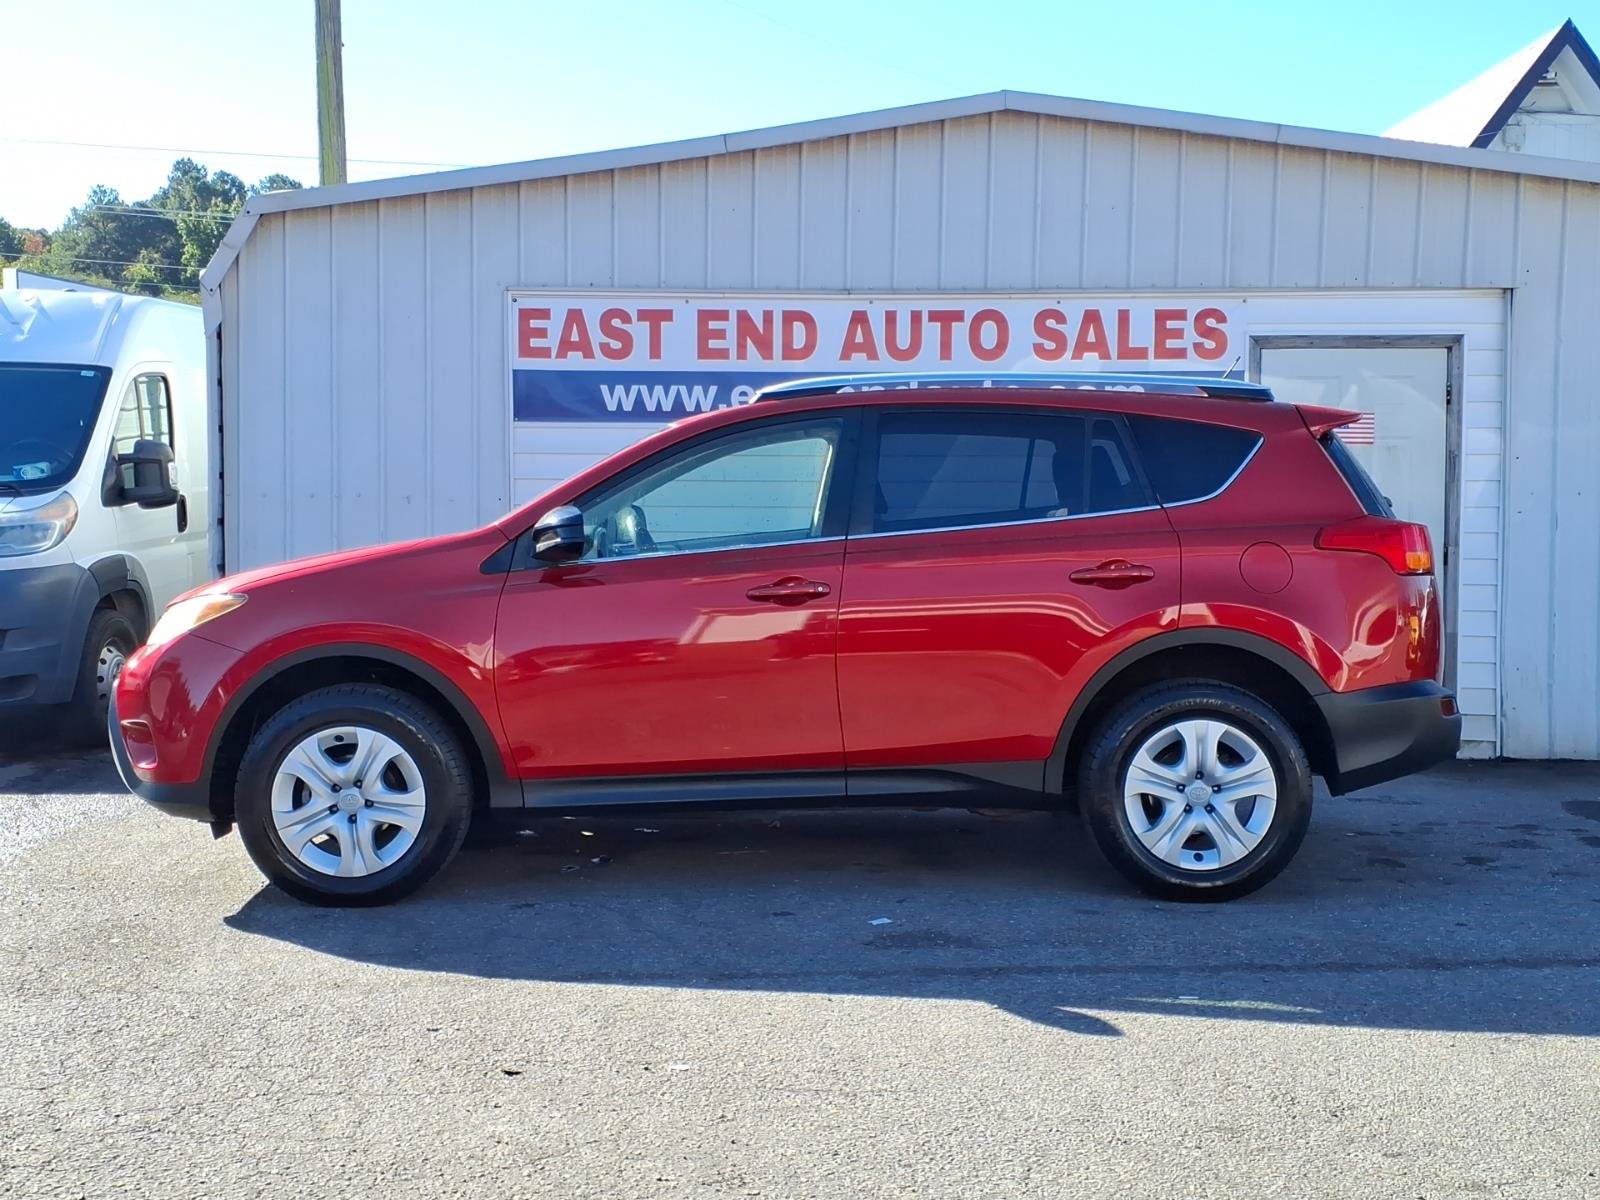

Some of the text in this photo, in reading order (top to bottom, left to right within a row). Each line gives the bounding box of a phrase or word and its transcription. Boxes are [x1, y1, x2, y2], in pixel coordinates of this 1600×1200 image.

[518, 307, 1229, 362] EAST END AUTO SALES
